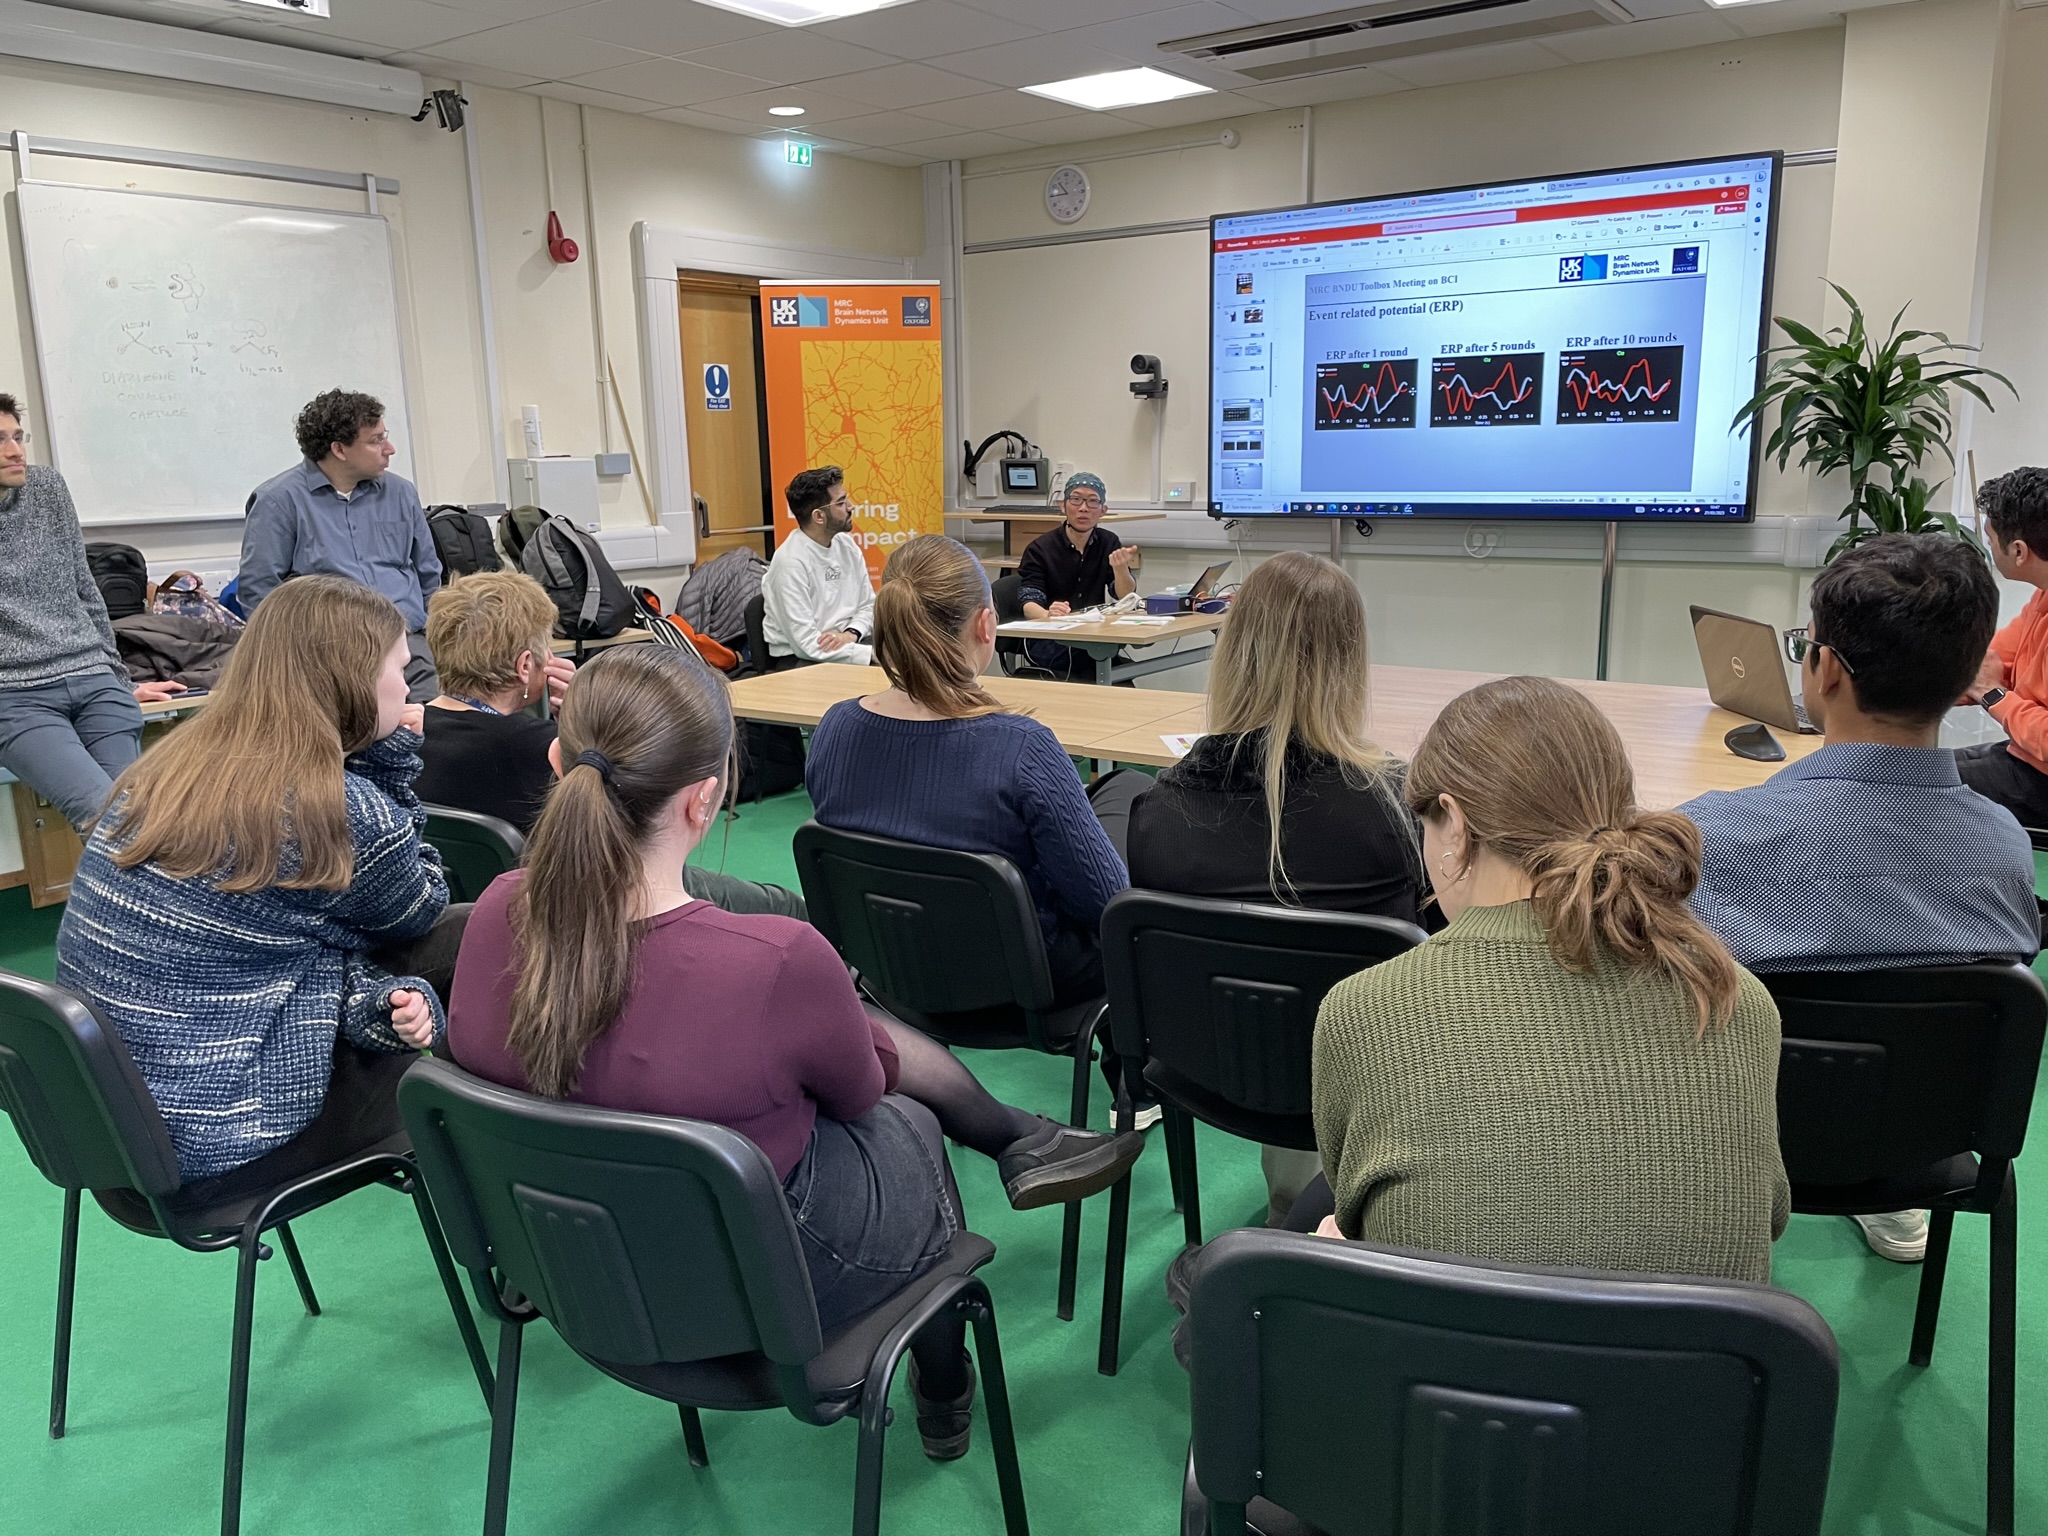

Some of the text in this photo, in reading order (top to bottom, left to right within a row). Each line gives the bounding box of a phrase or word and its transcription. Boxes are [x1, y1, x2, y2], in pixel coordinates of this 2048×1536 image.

[1562, 259, 1582, 270] UK
[1631, 260, 1660, 268] Network
[1561, 269, 1581, 281] RI
[1612, 269, 1645, 277] Dynamics
[1310, 285, 1330, 295] MRC
[1332, 283, 1358, 293] BNDU
[1360, 281, 1391, 291] Toolbox
[1393, 279, 1426, 288] Meeting
[1441, 275, 1458, 284] BCI
[772, 300, 798, 313] UK
[1309, 300, 1464, 321] Event related potential (ERP)
[773, 312, 798, 324] RI
[834, 317, 889, 326] Dynamics Unit
[1566, 332, 1677, 347] ERP after 10 rounds
[1441, 340, 1536, 354] ERP after 5 rounds
[1326, 350, 1346, 360] ERP
[1348, 350, 1370, 359] after
[1380, 347, 1408, 357] round
